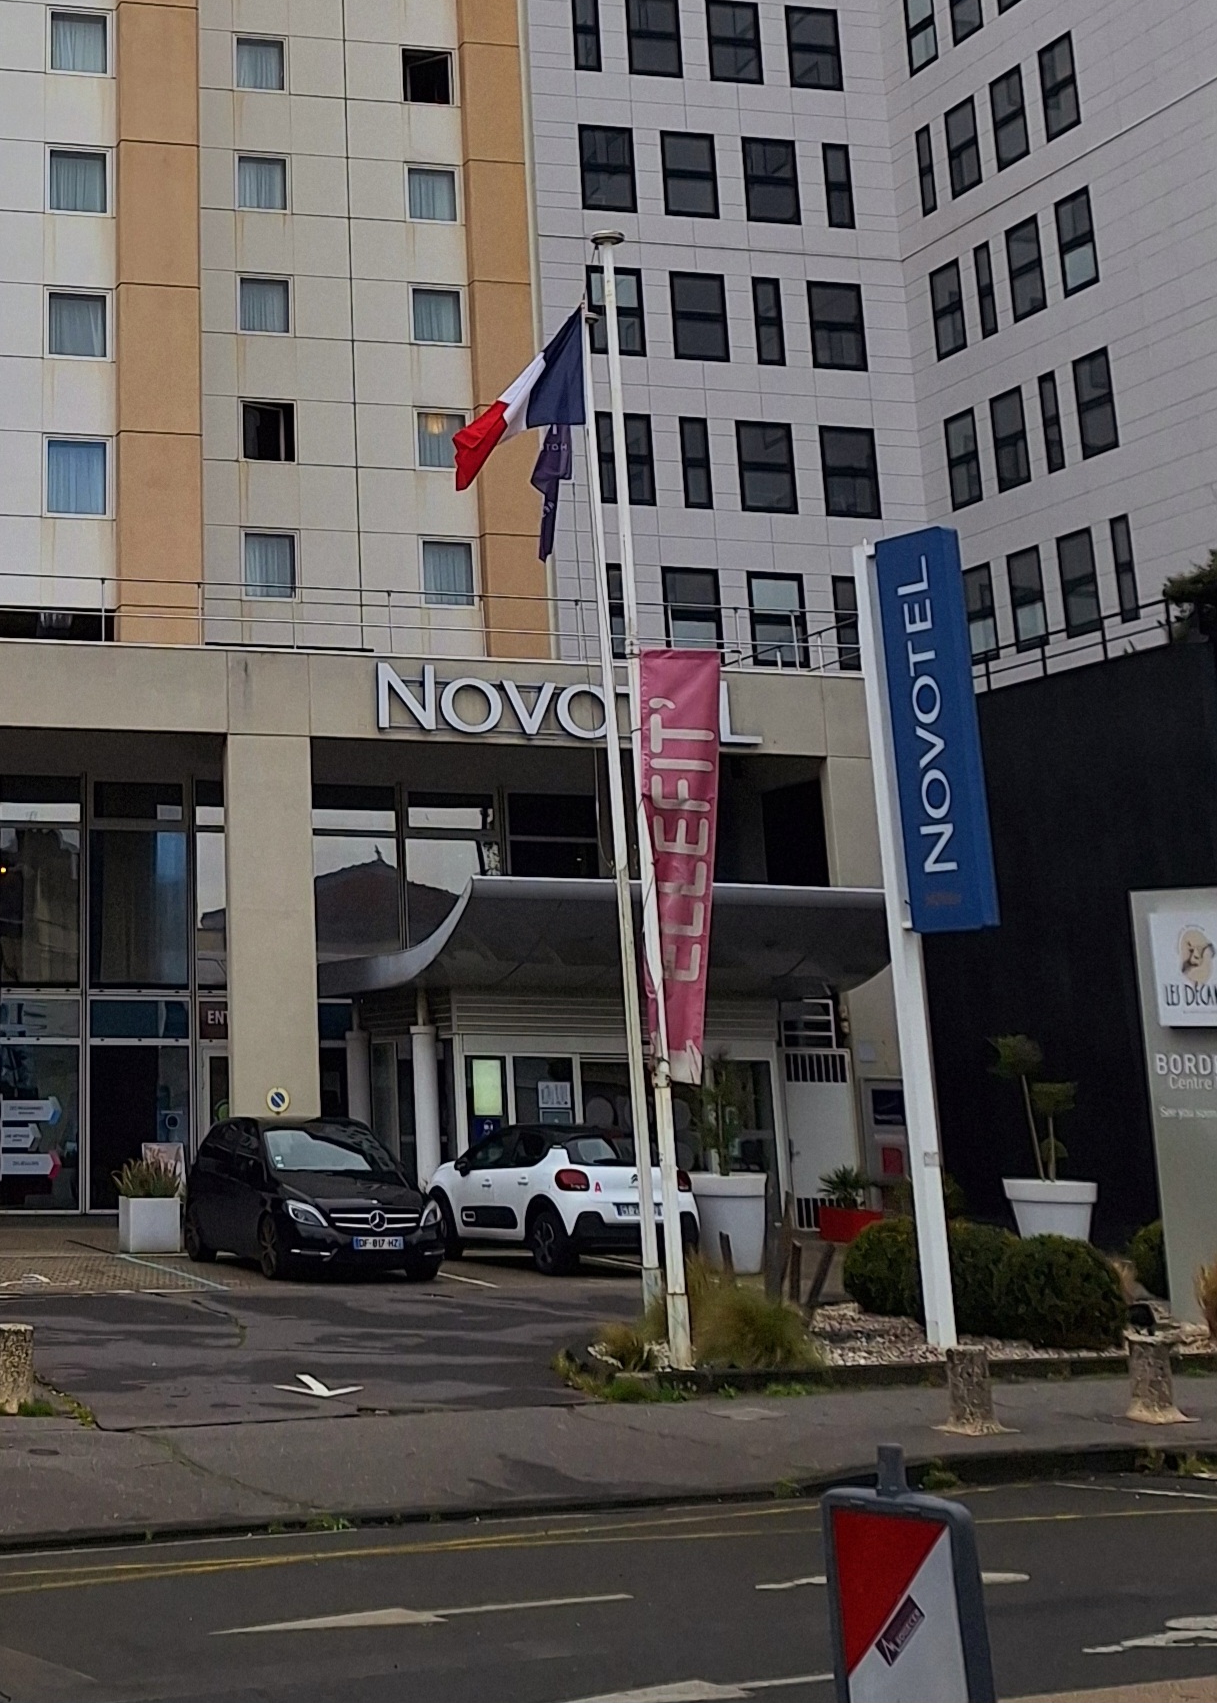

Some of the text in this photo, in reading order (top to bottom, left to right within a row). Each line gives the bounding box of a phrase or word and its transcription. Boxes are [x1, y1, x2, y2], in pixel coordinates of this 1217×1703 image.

[377, 662, 763, 744] NOVOL
[897, 555, 958, 873] NOVOTEL
[1165, 981, 1217, 1006] LES DÉCA
[207, 1010, 228, 1025] EN
[1169, 1074, 1213, 1090] Centre
[594, 1181, 602, 1193] A
